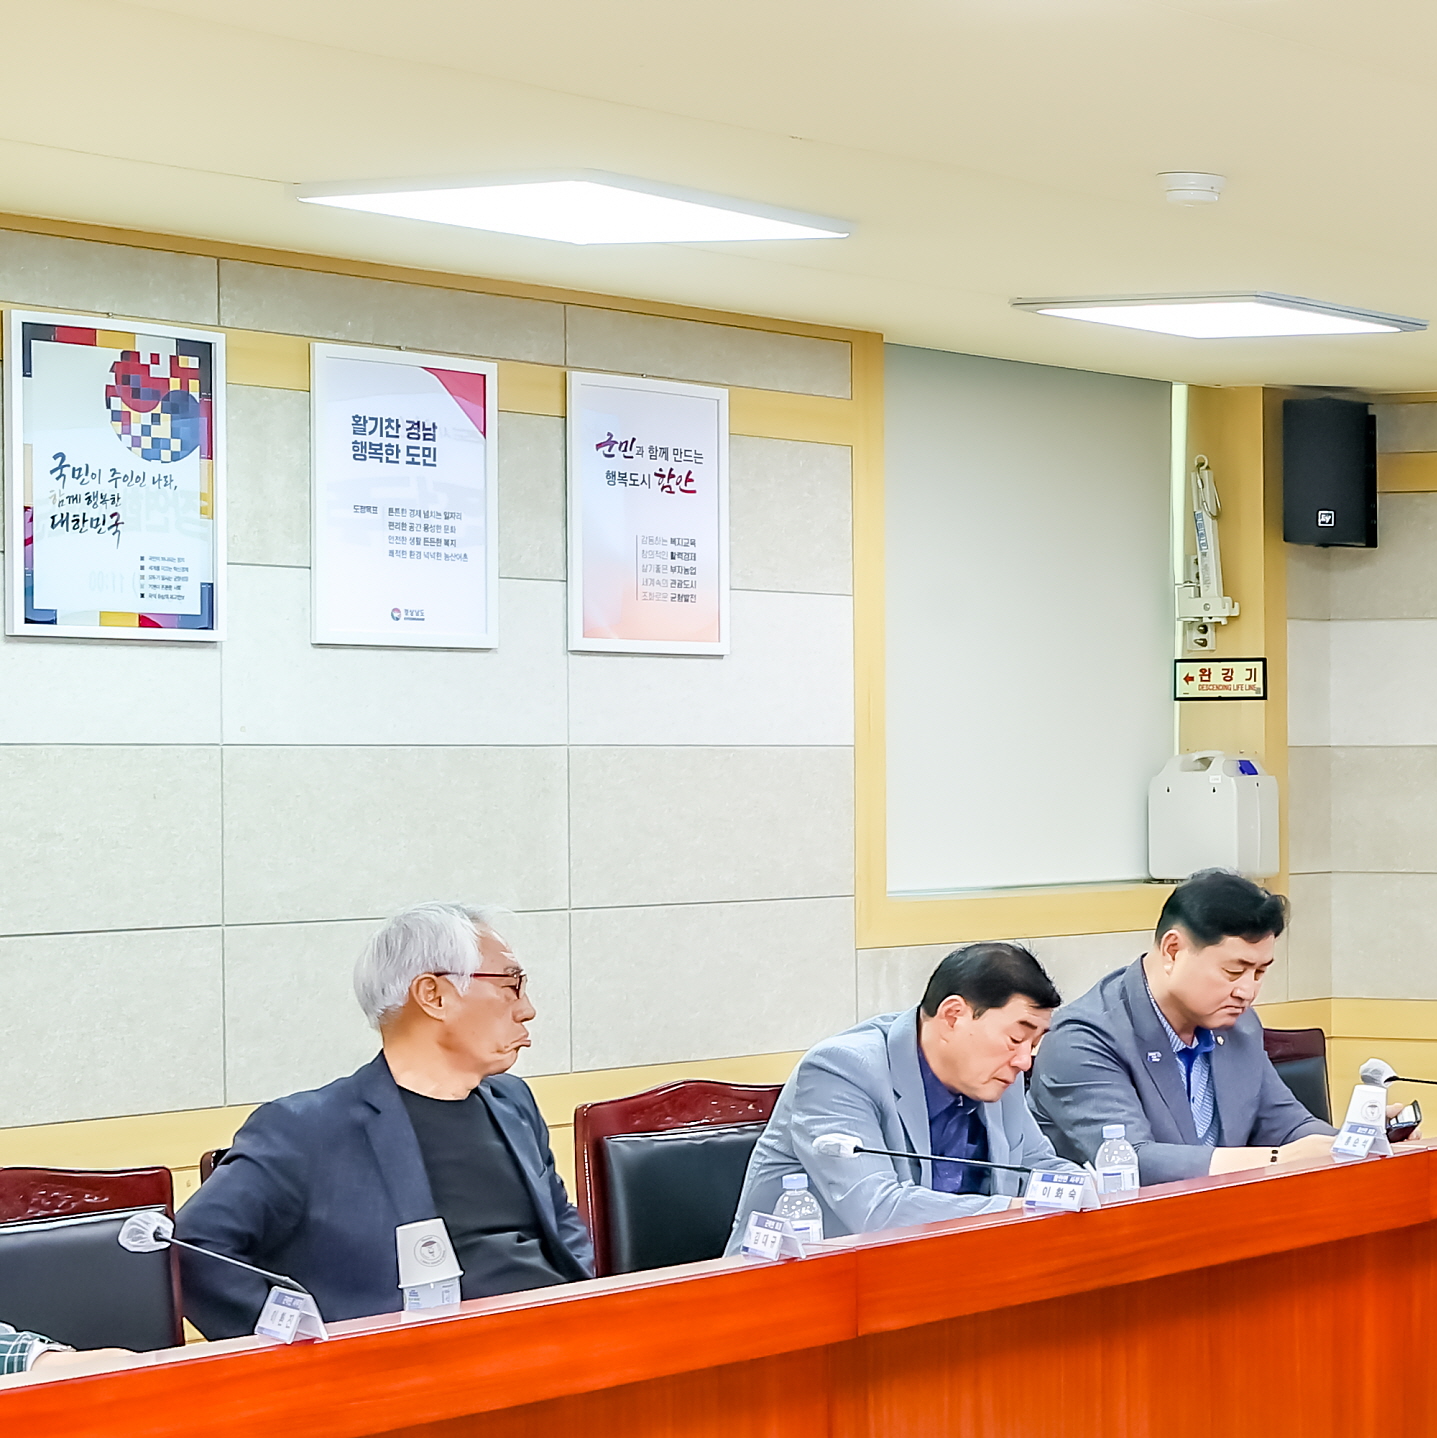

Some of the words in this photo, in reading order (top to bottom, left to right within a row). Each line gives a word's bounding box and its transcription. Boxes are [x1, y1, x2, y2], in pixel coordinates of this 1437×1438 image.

[351, 413, 401, 439] 활기찬
[405, 419, 438, 443] 경남
[351, 439, 401, 465] 행복한
[405, 444, 437, 468] 도민
[595, 431, 644, 459] 군민과
[648, 445, 669, 462] 함께
[672, 447, 704, 465] 만드는
[49, 452, 102, 489] 국민이
[107, 467, 146, 489] 주인인
[605, 469, 651, 489] 행복도시
[653, 467, 697, 495] 함안
[49, 489, 82, 508] 함께
[84, 490, 122, 510] 행복한
[49, 511, 125, 550] 대한민국
[1198, 667, 1257, 683] 완강기
[1232, 683, 1245, 691] LIFE
